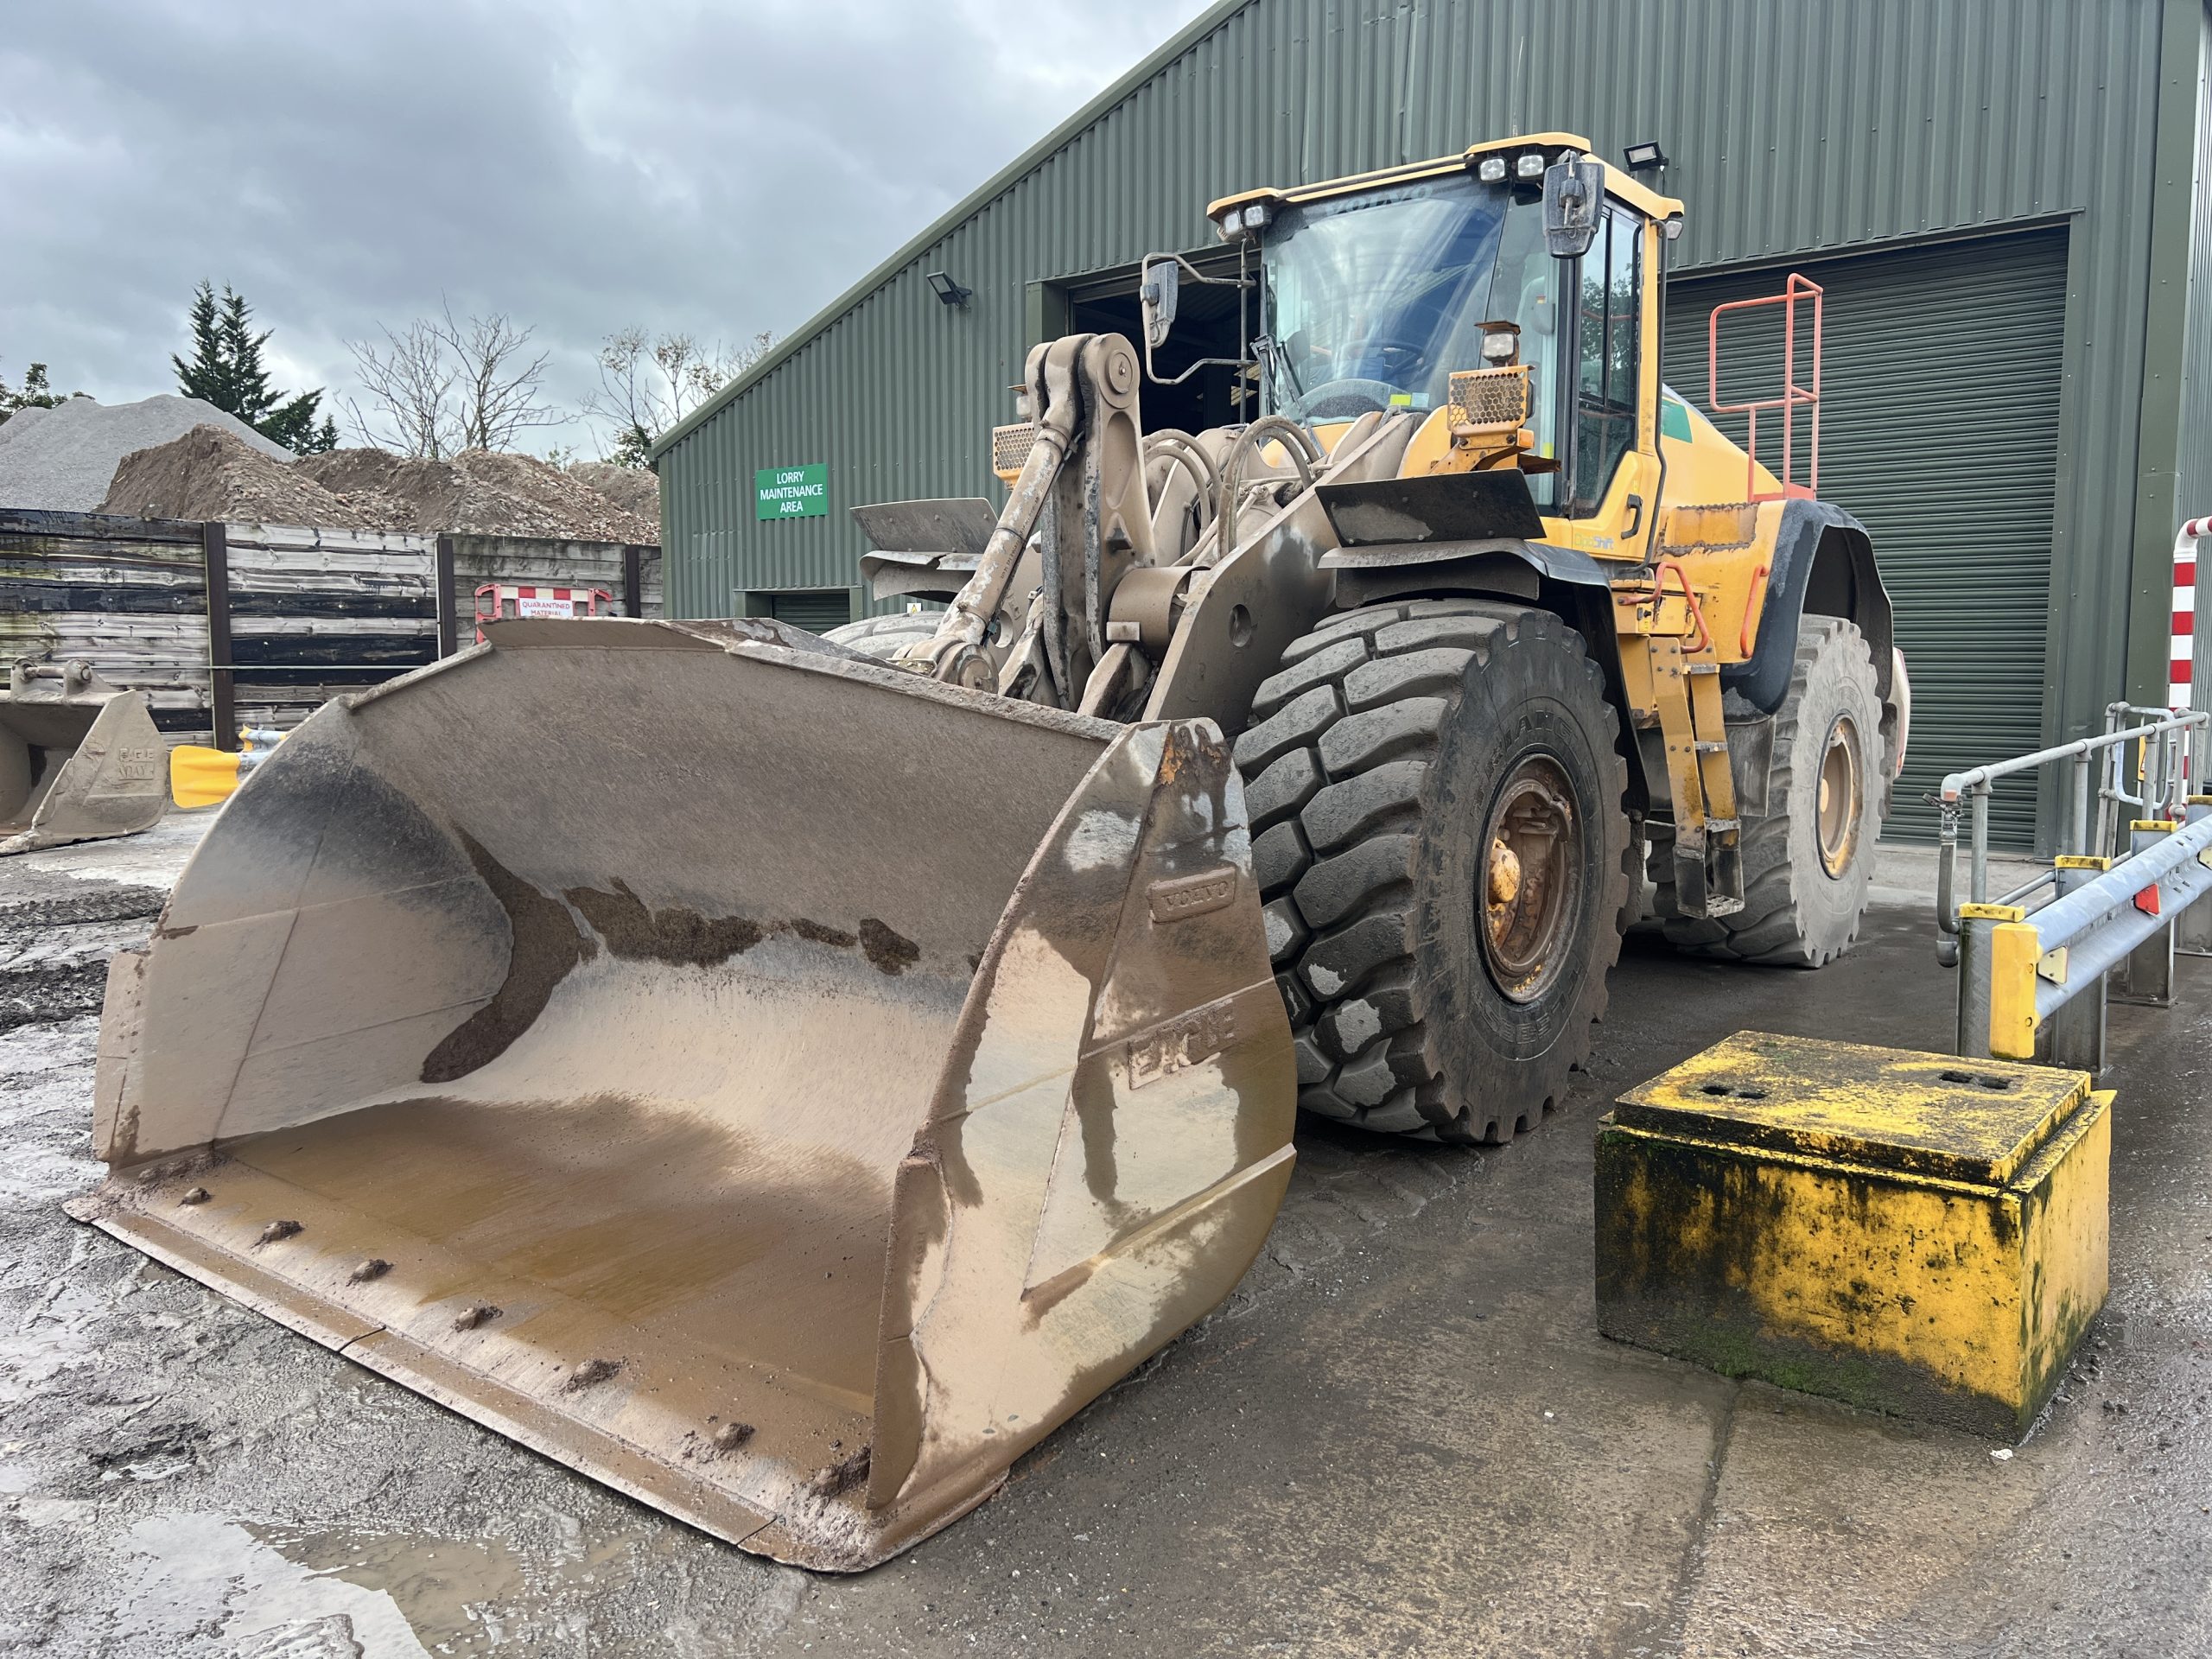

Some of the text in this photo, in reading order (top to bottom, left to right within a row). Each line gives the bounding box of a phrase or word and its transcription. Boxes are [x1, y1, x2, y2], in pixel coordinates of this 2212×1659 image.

[777, 471, 804, 484] LORRY
[760, 484, 823, 500] MAINTENANCE
[780, 501, 803, 513] AREA
